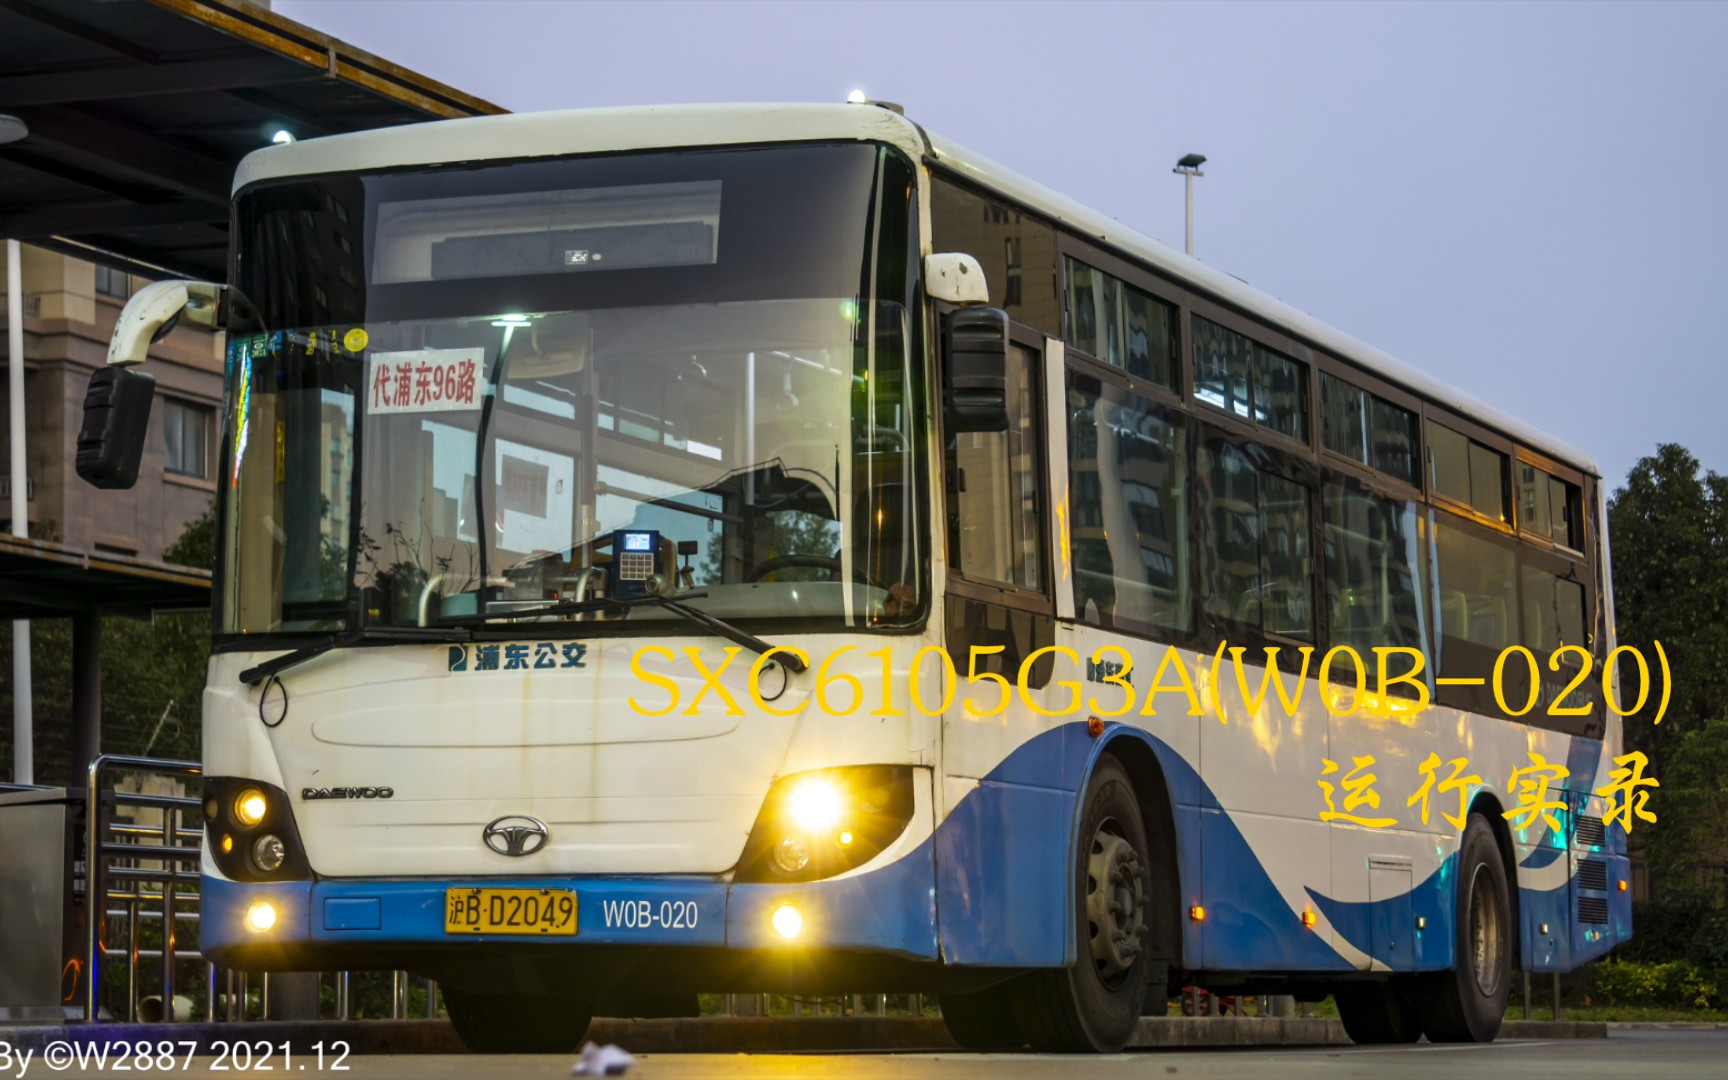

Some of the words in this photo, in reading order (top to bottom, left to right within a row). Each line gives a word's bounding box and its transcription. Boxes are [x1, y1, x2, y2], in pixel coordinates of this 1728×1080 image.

[374, 359, 476, 408] 代浦东96路
[475, 642, 587, 671] 浦东公交
[302, 787, 394, 800] DAEWOO
